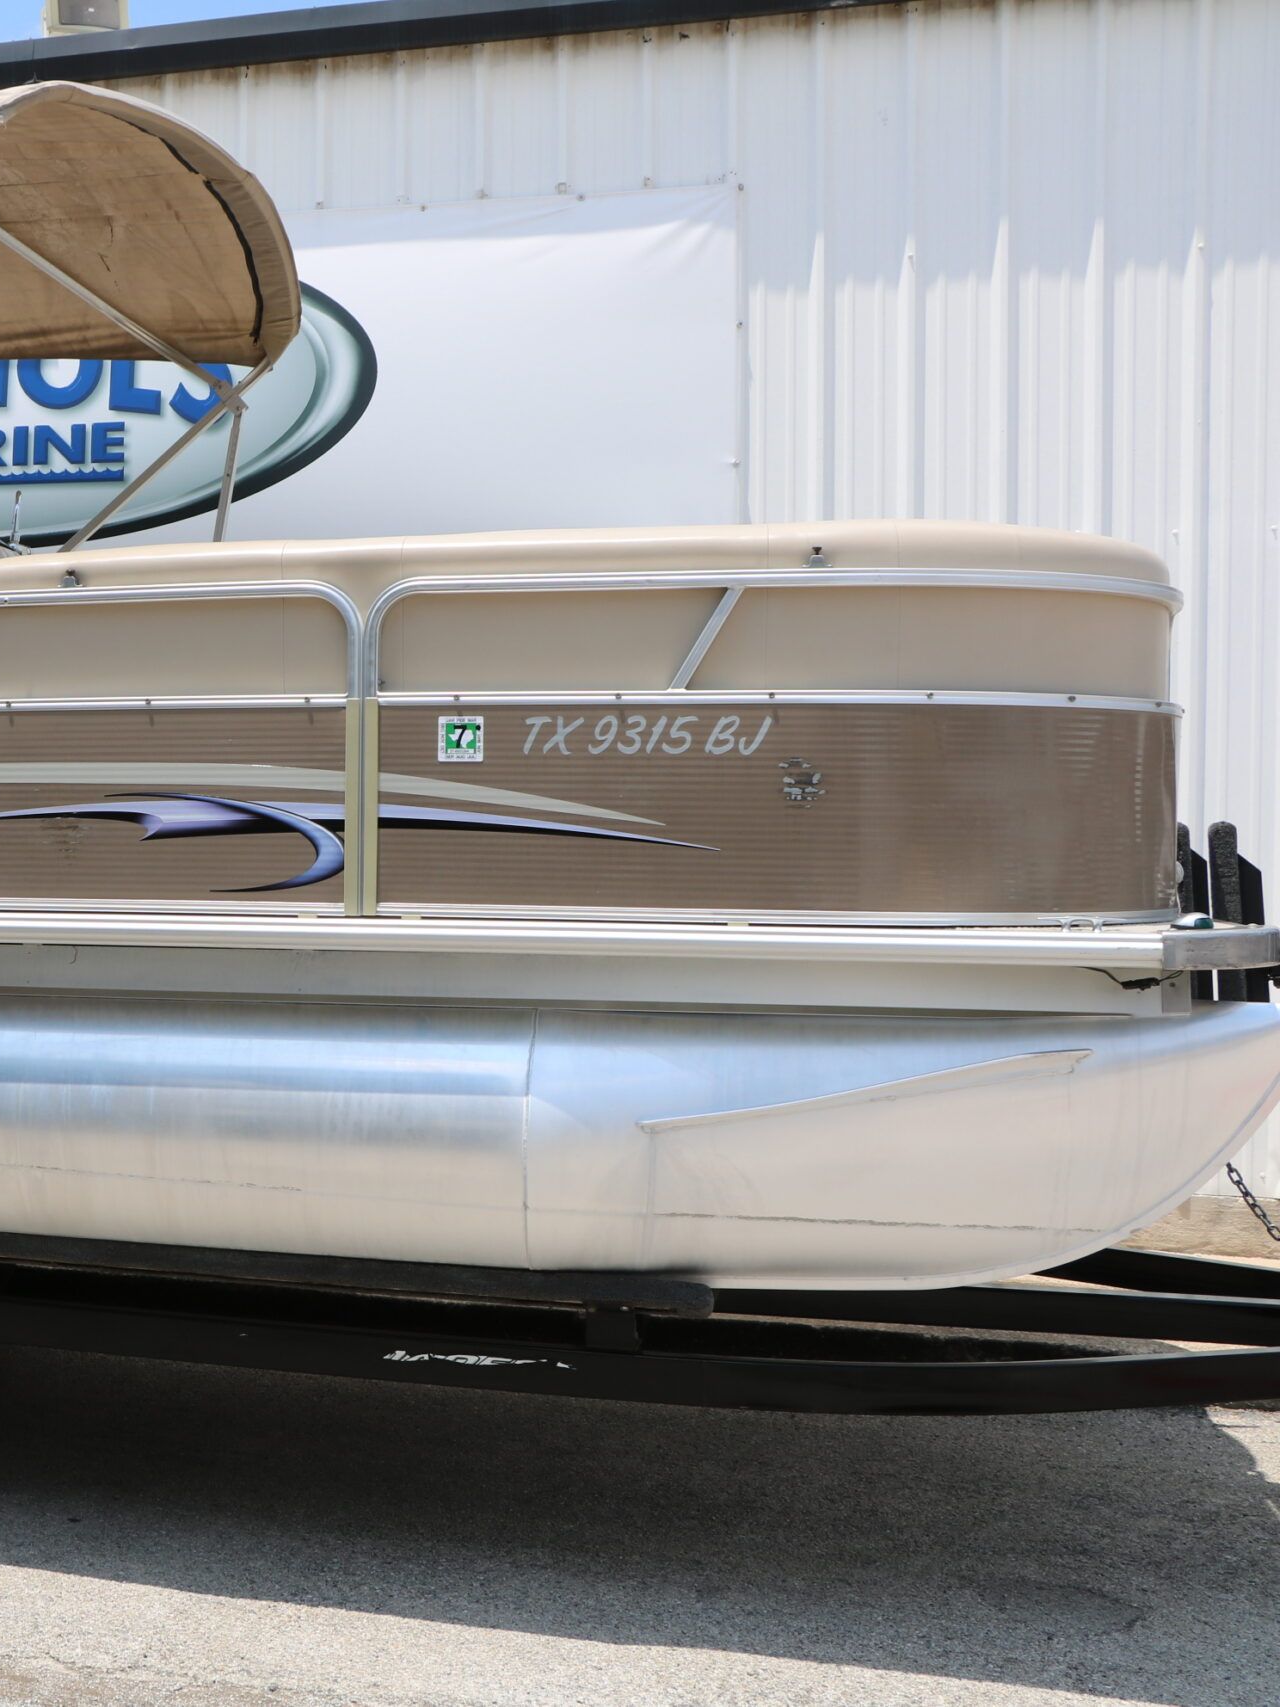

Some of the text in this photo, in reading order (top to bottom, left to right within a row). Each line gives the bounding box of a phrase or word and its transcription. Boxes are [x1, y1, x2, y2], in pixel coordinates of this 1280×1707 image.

[453, 724, 467, 748] 7
[522, 715, 585, 755] TX
[588, 714, 699, 755] 9315
[704, 714, 772, 756] BJ
